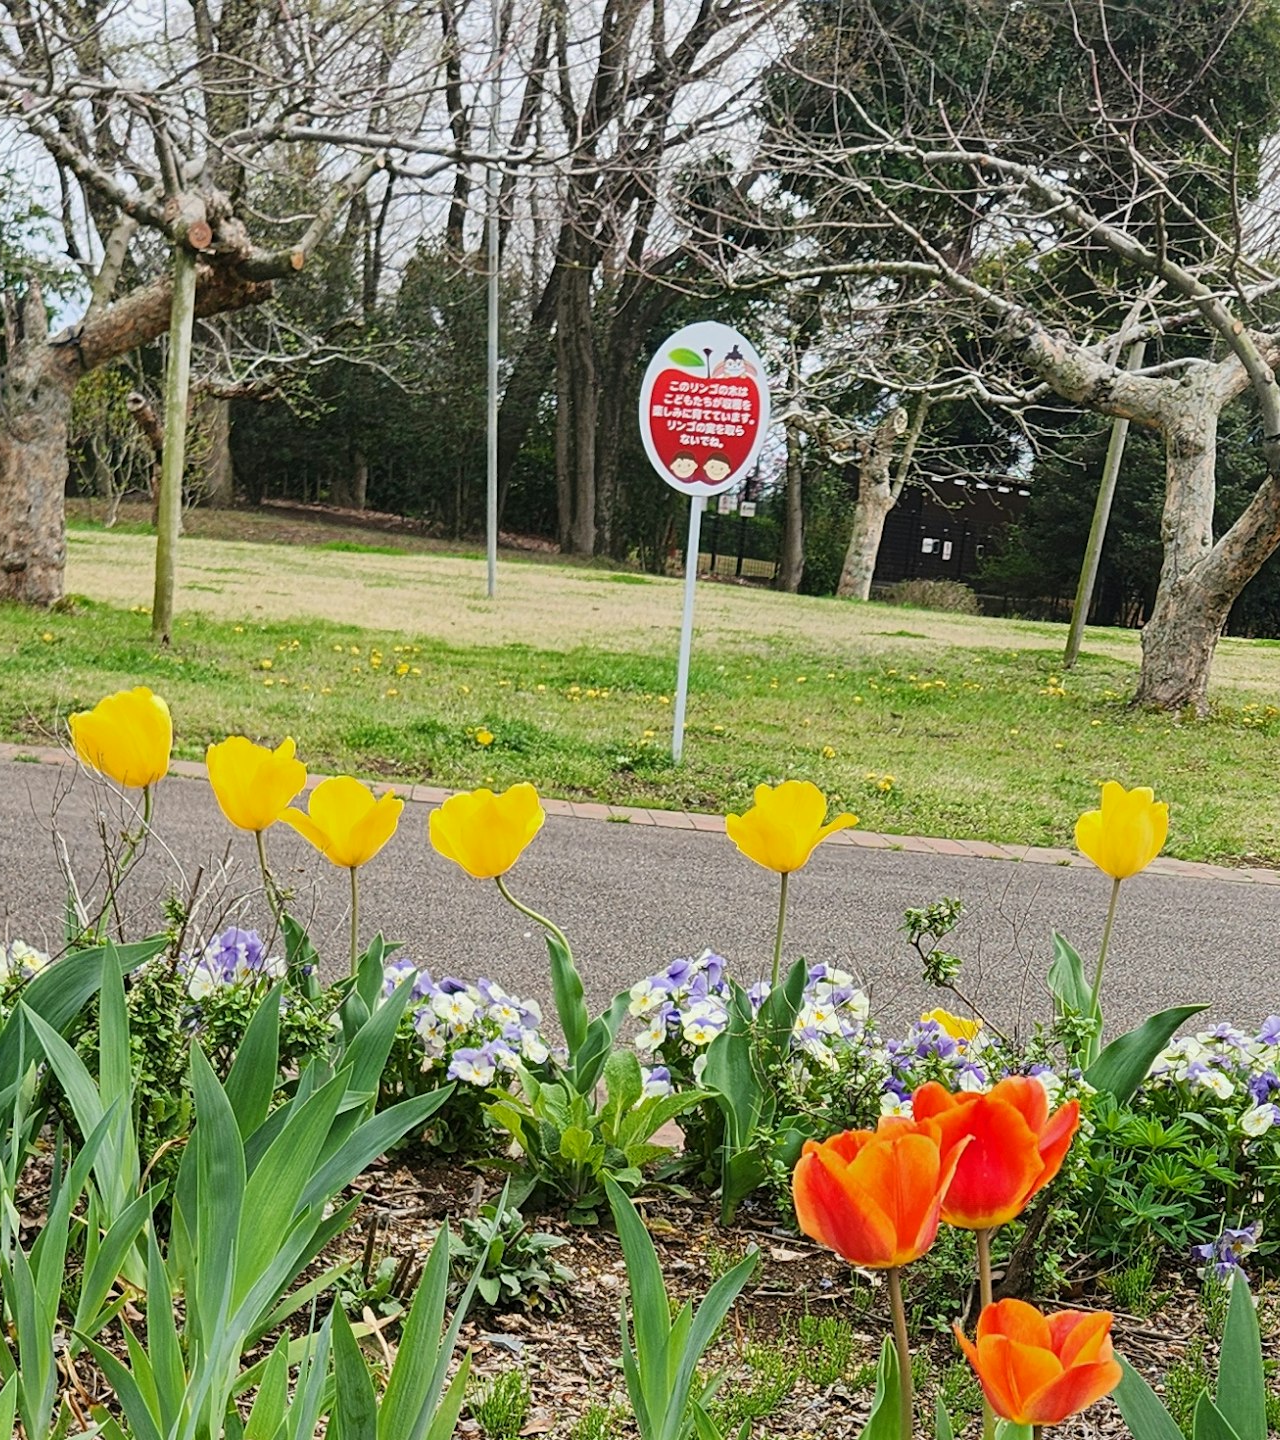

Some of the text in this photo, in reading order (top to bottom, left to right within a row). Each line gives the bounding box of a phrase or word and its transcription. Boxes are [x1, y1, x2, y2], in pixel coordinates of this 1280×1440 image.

[669, 381, 749, 397] このリンゴの木は
[667, 420, 745, 437] リンゴの実を取ら
[680, 434, 724, 449] ないでね。
